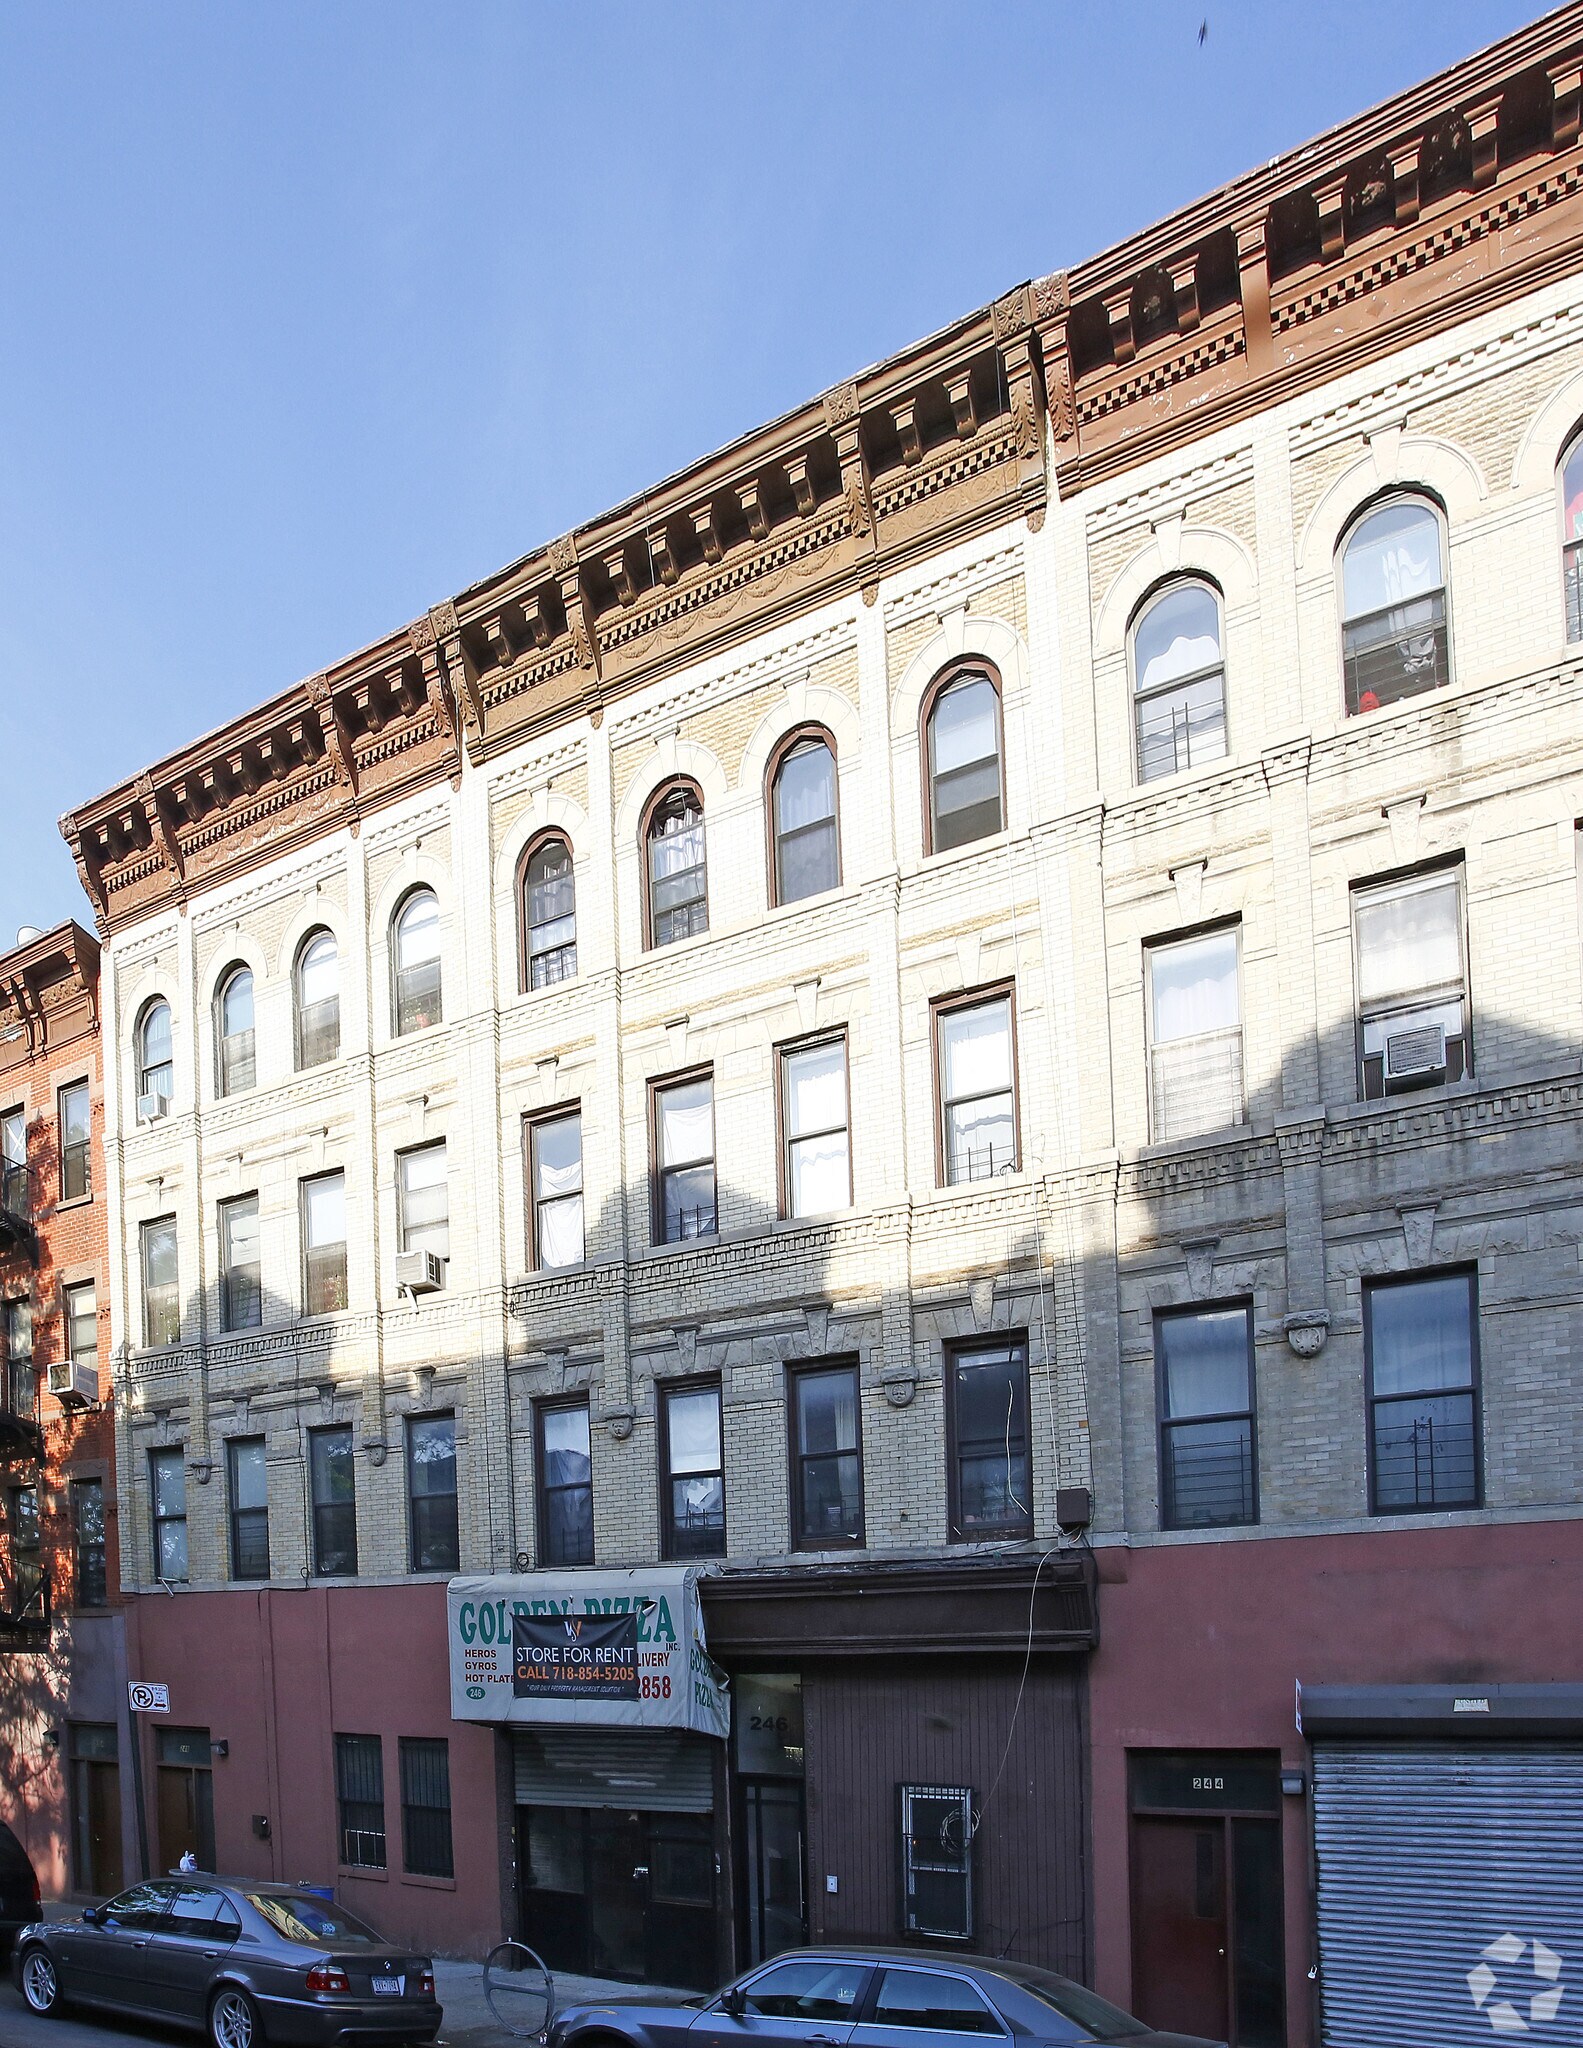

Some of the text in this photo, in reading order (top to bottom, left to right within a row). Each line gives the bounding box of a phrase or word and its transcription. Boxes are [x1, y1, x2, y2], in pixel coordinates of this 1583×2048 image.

[665, 1642, 681, 1651] INC.
[465, 1649, 497, 1658] HEROS
[516, 1647, 634, 1663] STORE FOR RENT
[465, 1662, 498, 1671] GYROS
[465, 1674, 484, 1682] HOT
[517, 1666, 635, 1680] CALL 718-854-5205
[470, 1688, 482, 1698] 246
[749, 1716, 788, 1731] 246
[1193, 1778, 1223, 1789] 244
